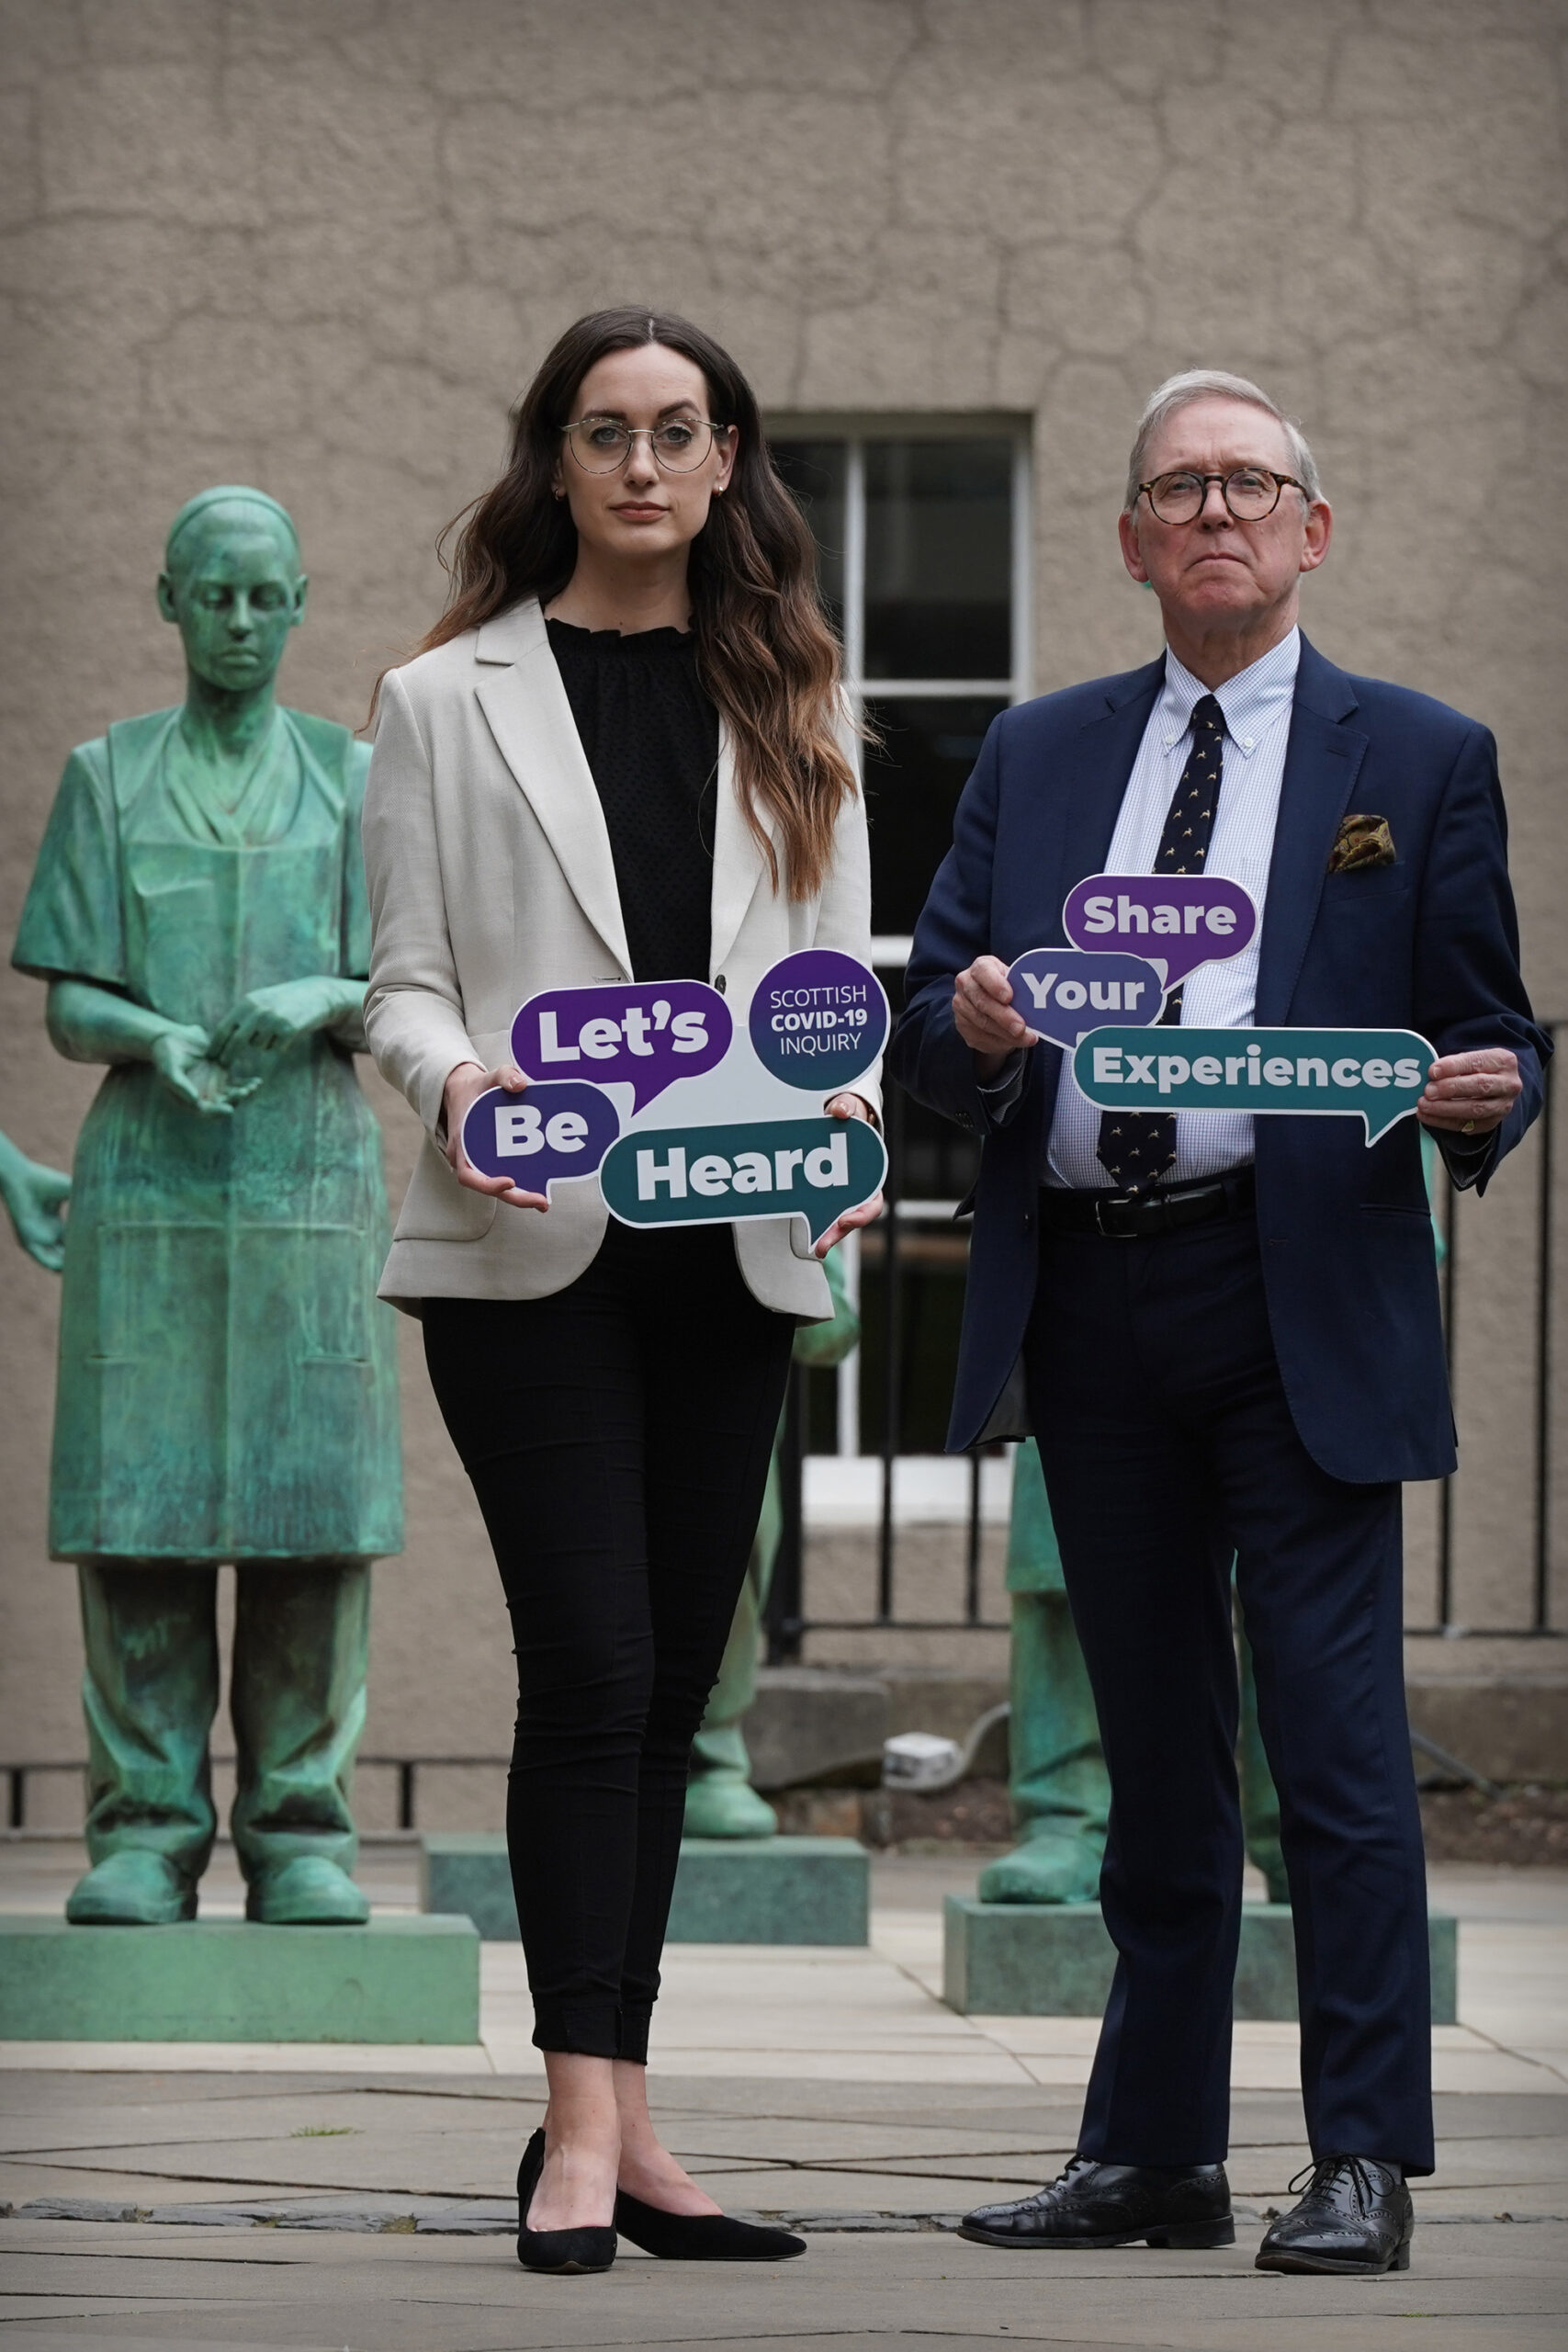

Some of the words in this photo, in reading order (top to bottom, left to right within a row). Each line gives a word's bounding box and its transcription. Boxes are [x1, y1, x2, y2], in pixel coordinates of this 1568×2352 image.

[1083, 895, 1237, 935] Share
[770, 984, 866, 1009] SCOTTISH
[1021, 972, 1145, 1011] Your
[538, 1000, 708, 1063] Let’s
[771, 1009, 867, 1033] COVID-19
[780, 1032, 862, 1057] INQUIRY
[1093, 1044, 1422, 1093] Experiences
[494, 1104, 589, 1158] Be
[636, 1132, 849, 1202] Heard
